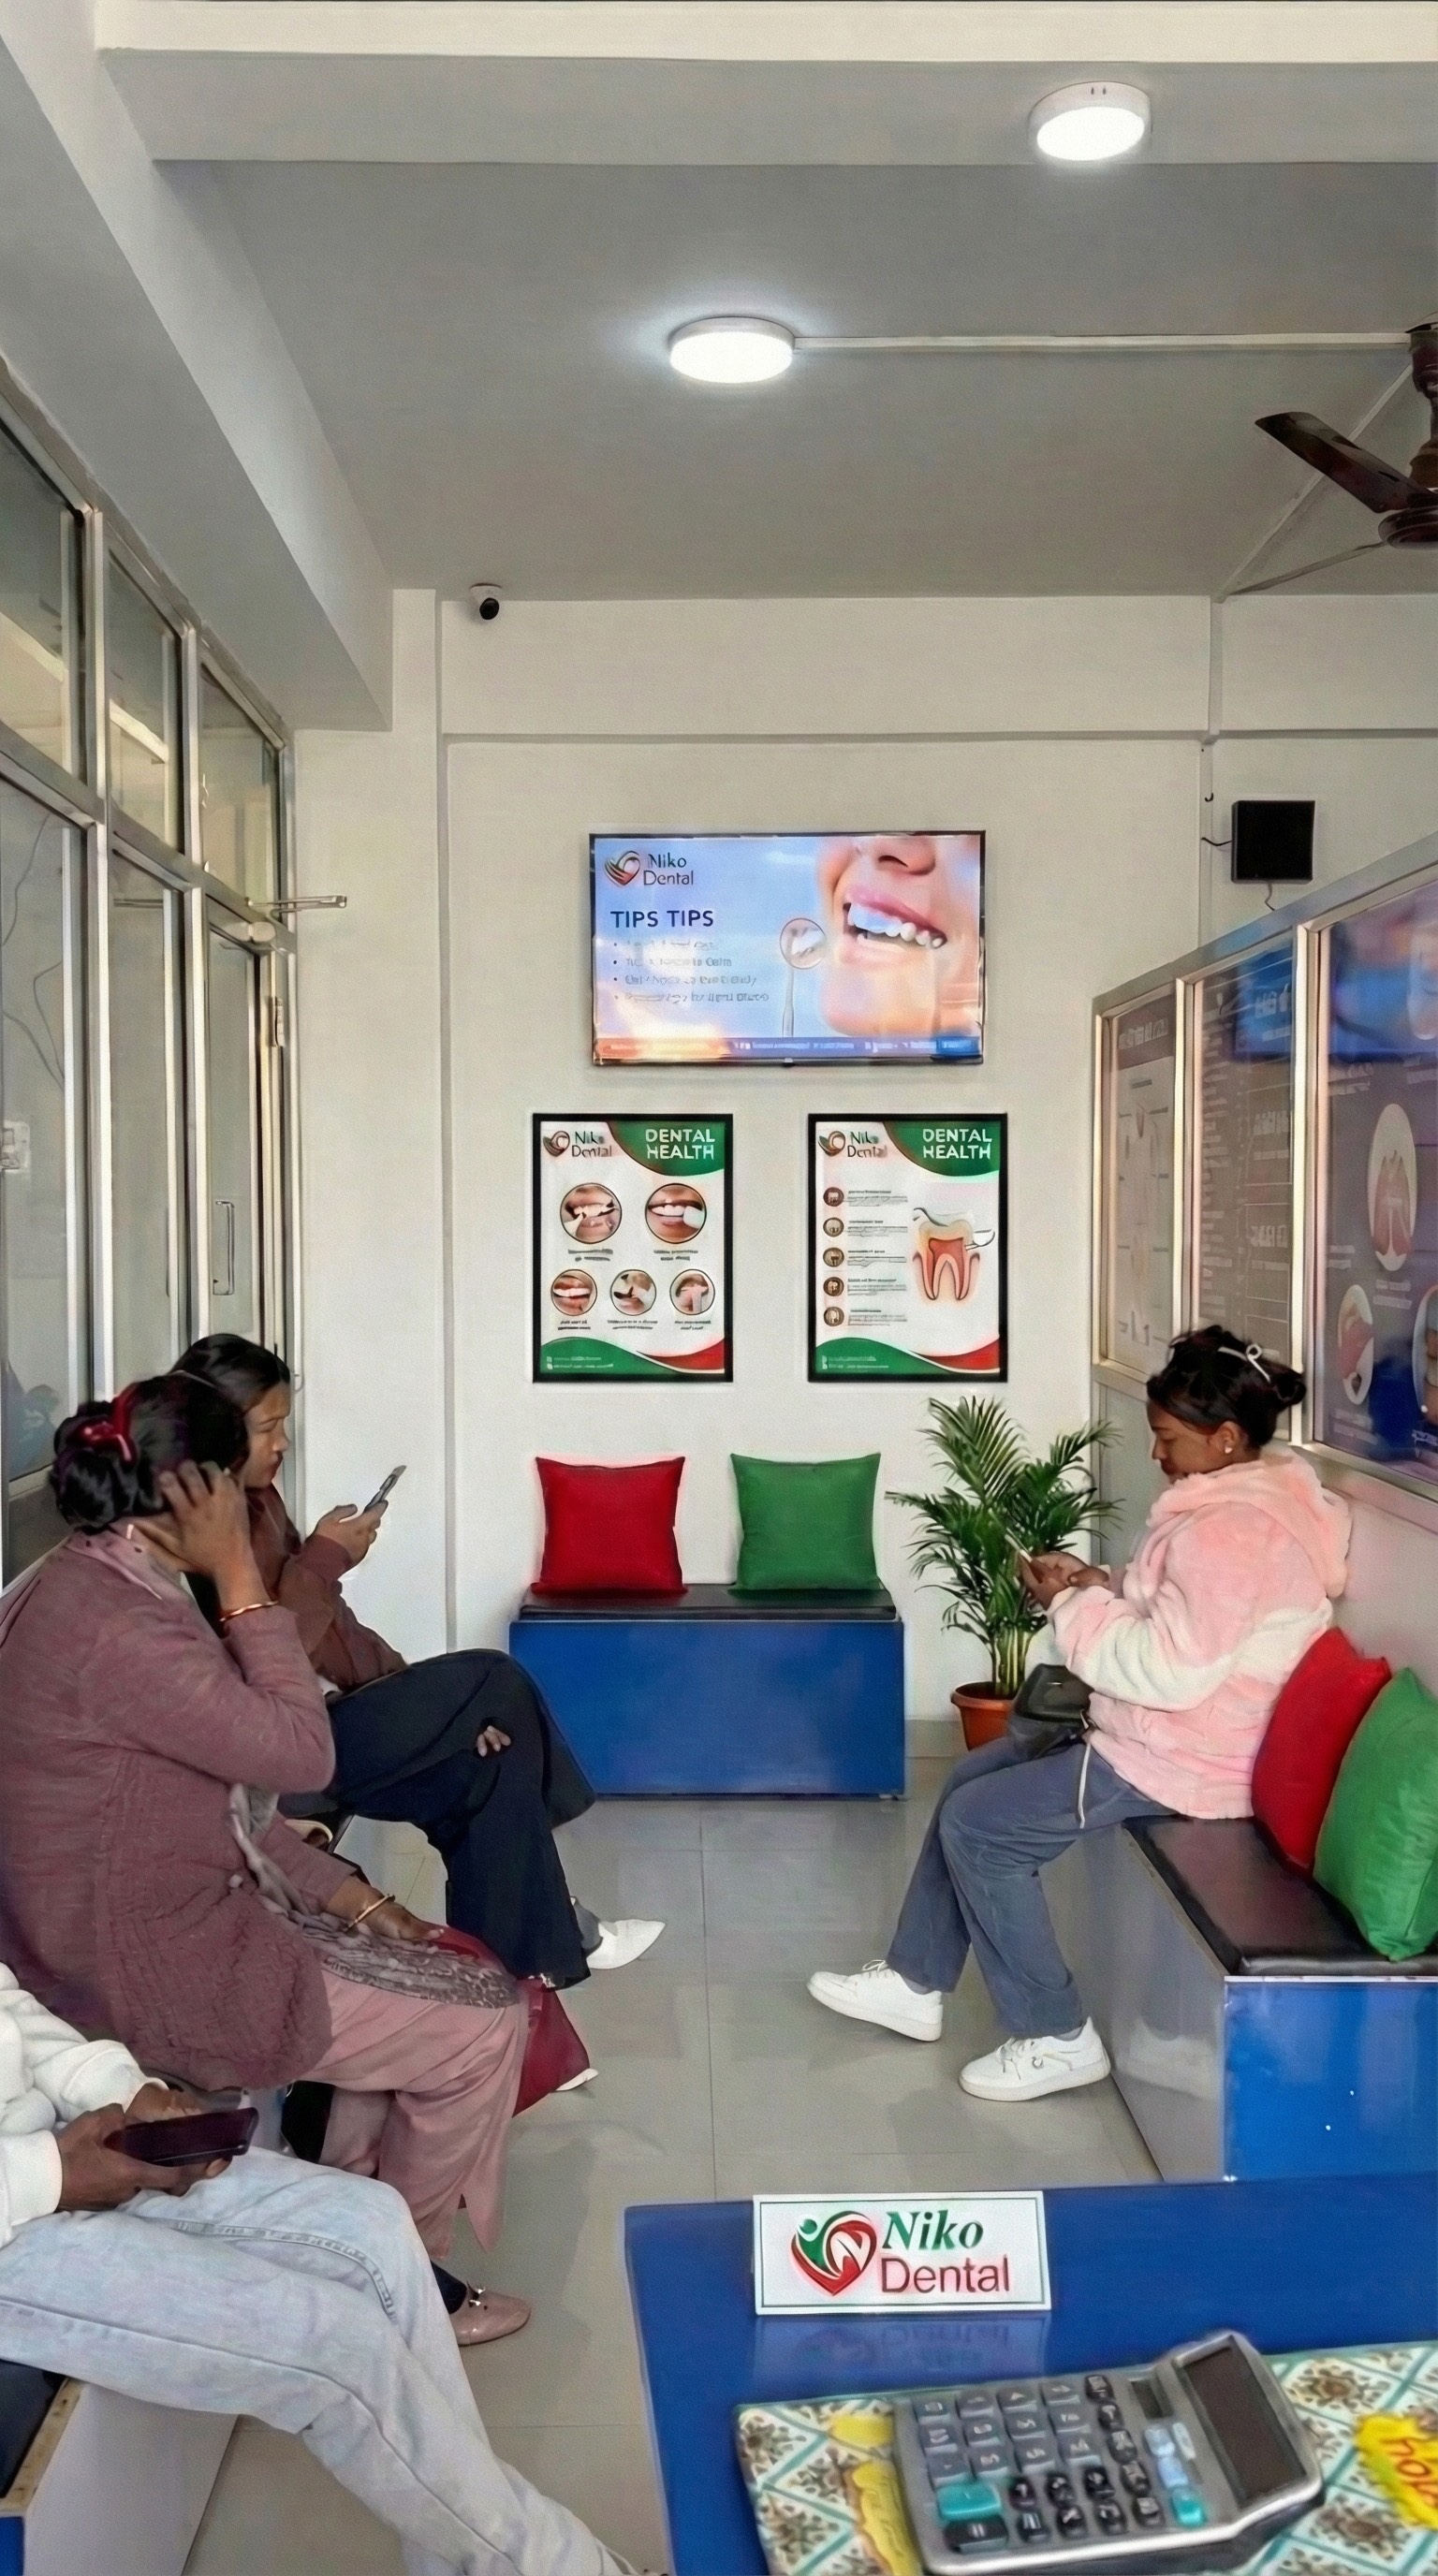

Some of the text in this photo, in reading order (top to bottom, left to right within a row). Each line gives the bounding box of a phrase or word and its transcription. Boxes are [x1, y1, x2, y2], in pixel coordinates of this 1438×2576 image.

[648, 853, 687, 869] Niko
[643, 871, 694, 886] Dental
[610, 910, 713, 928] TIPS TIPS
[645, 1129, 715, 1143] DENTAL
[922, 1129, 992, 1143] DENTAL
[646, 1144, 714, 1160] HEALTH
[923, 1144, 991, 1159] HEALTH
[882, 2210, 984, 2250] Niko
[881, 2254, 1010, 2294] Dental
